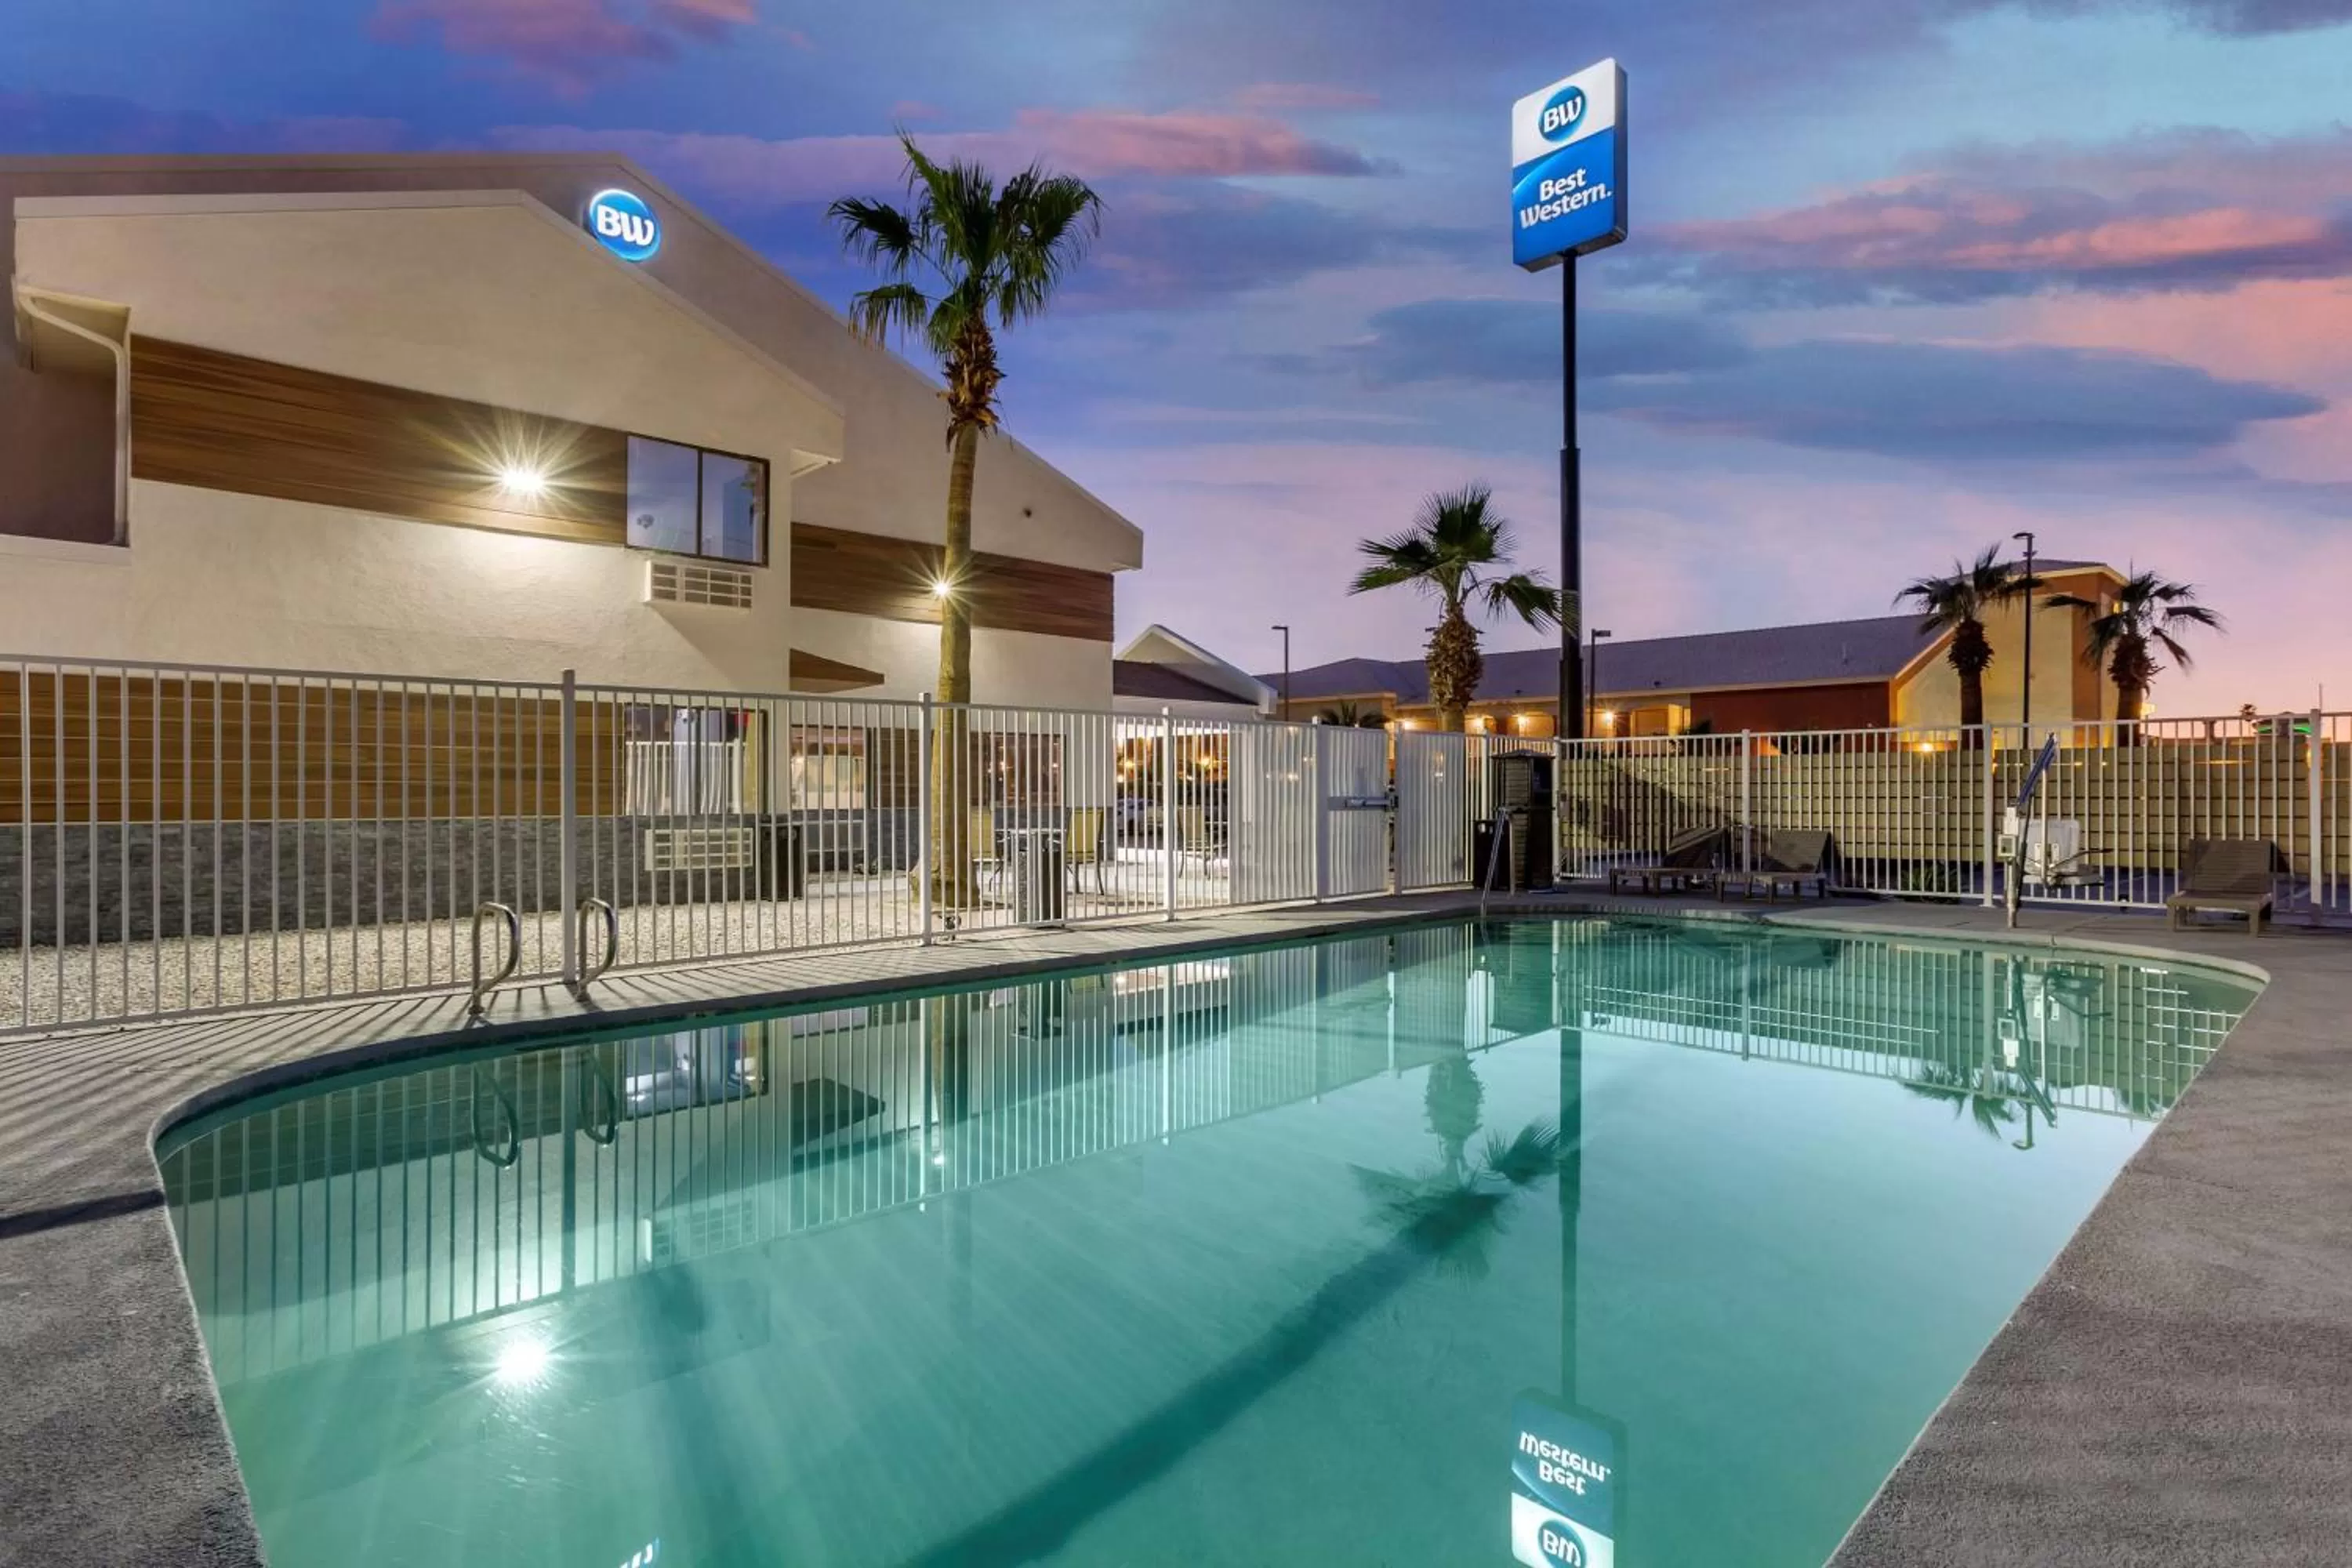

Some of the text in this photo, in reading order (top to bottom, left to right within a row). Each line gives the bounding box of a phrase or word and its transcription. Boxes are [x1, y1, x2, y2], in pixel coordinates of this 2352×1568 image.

[1543, 96, 1581, 132] BW
[1540, 168, 1586, 201] Best
[597, 204, 655, 245] BW
